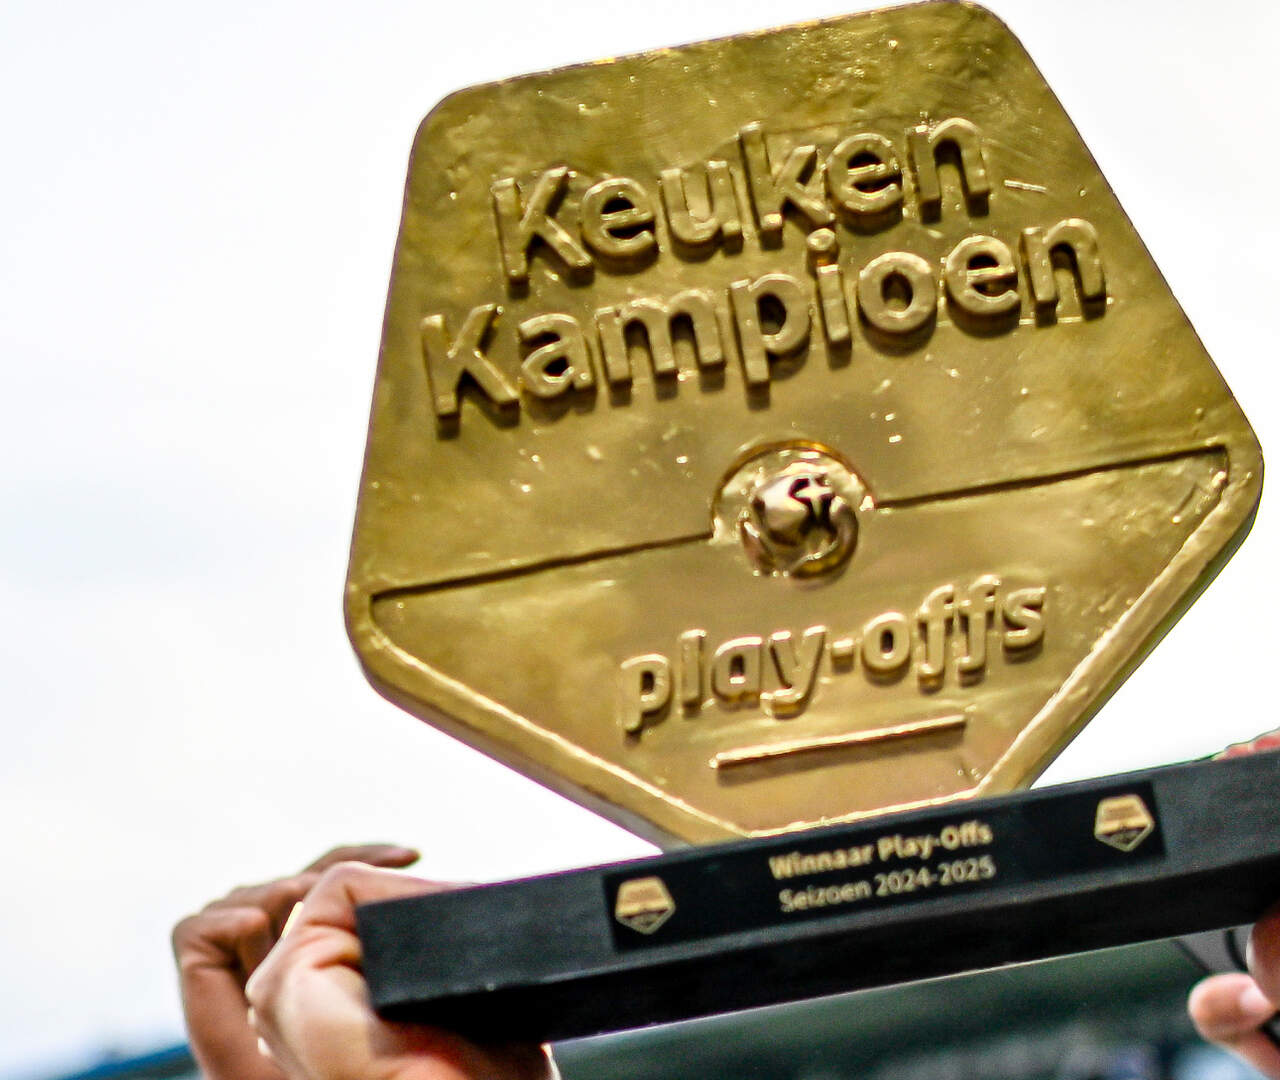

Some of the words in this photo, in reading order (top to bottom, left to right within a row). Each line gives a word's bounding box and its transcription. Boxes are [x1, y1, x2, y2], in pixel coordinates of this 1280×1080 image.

[491, 117, 992, 292] Keuken
[420, 218, 1109, 425] Kampioen
[620, 574, 1048, 736] play-offs
[769, 844, 874, 880] Winnaar
[877, 820, 994, 861] Play-Offs
[778, 880, 873, 912] Seizoen
[874, 854, 997, 897] 2024-2025
